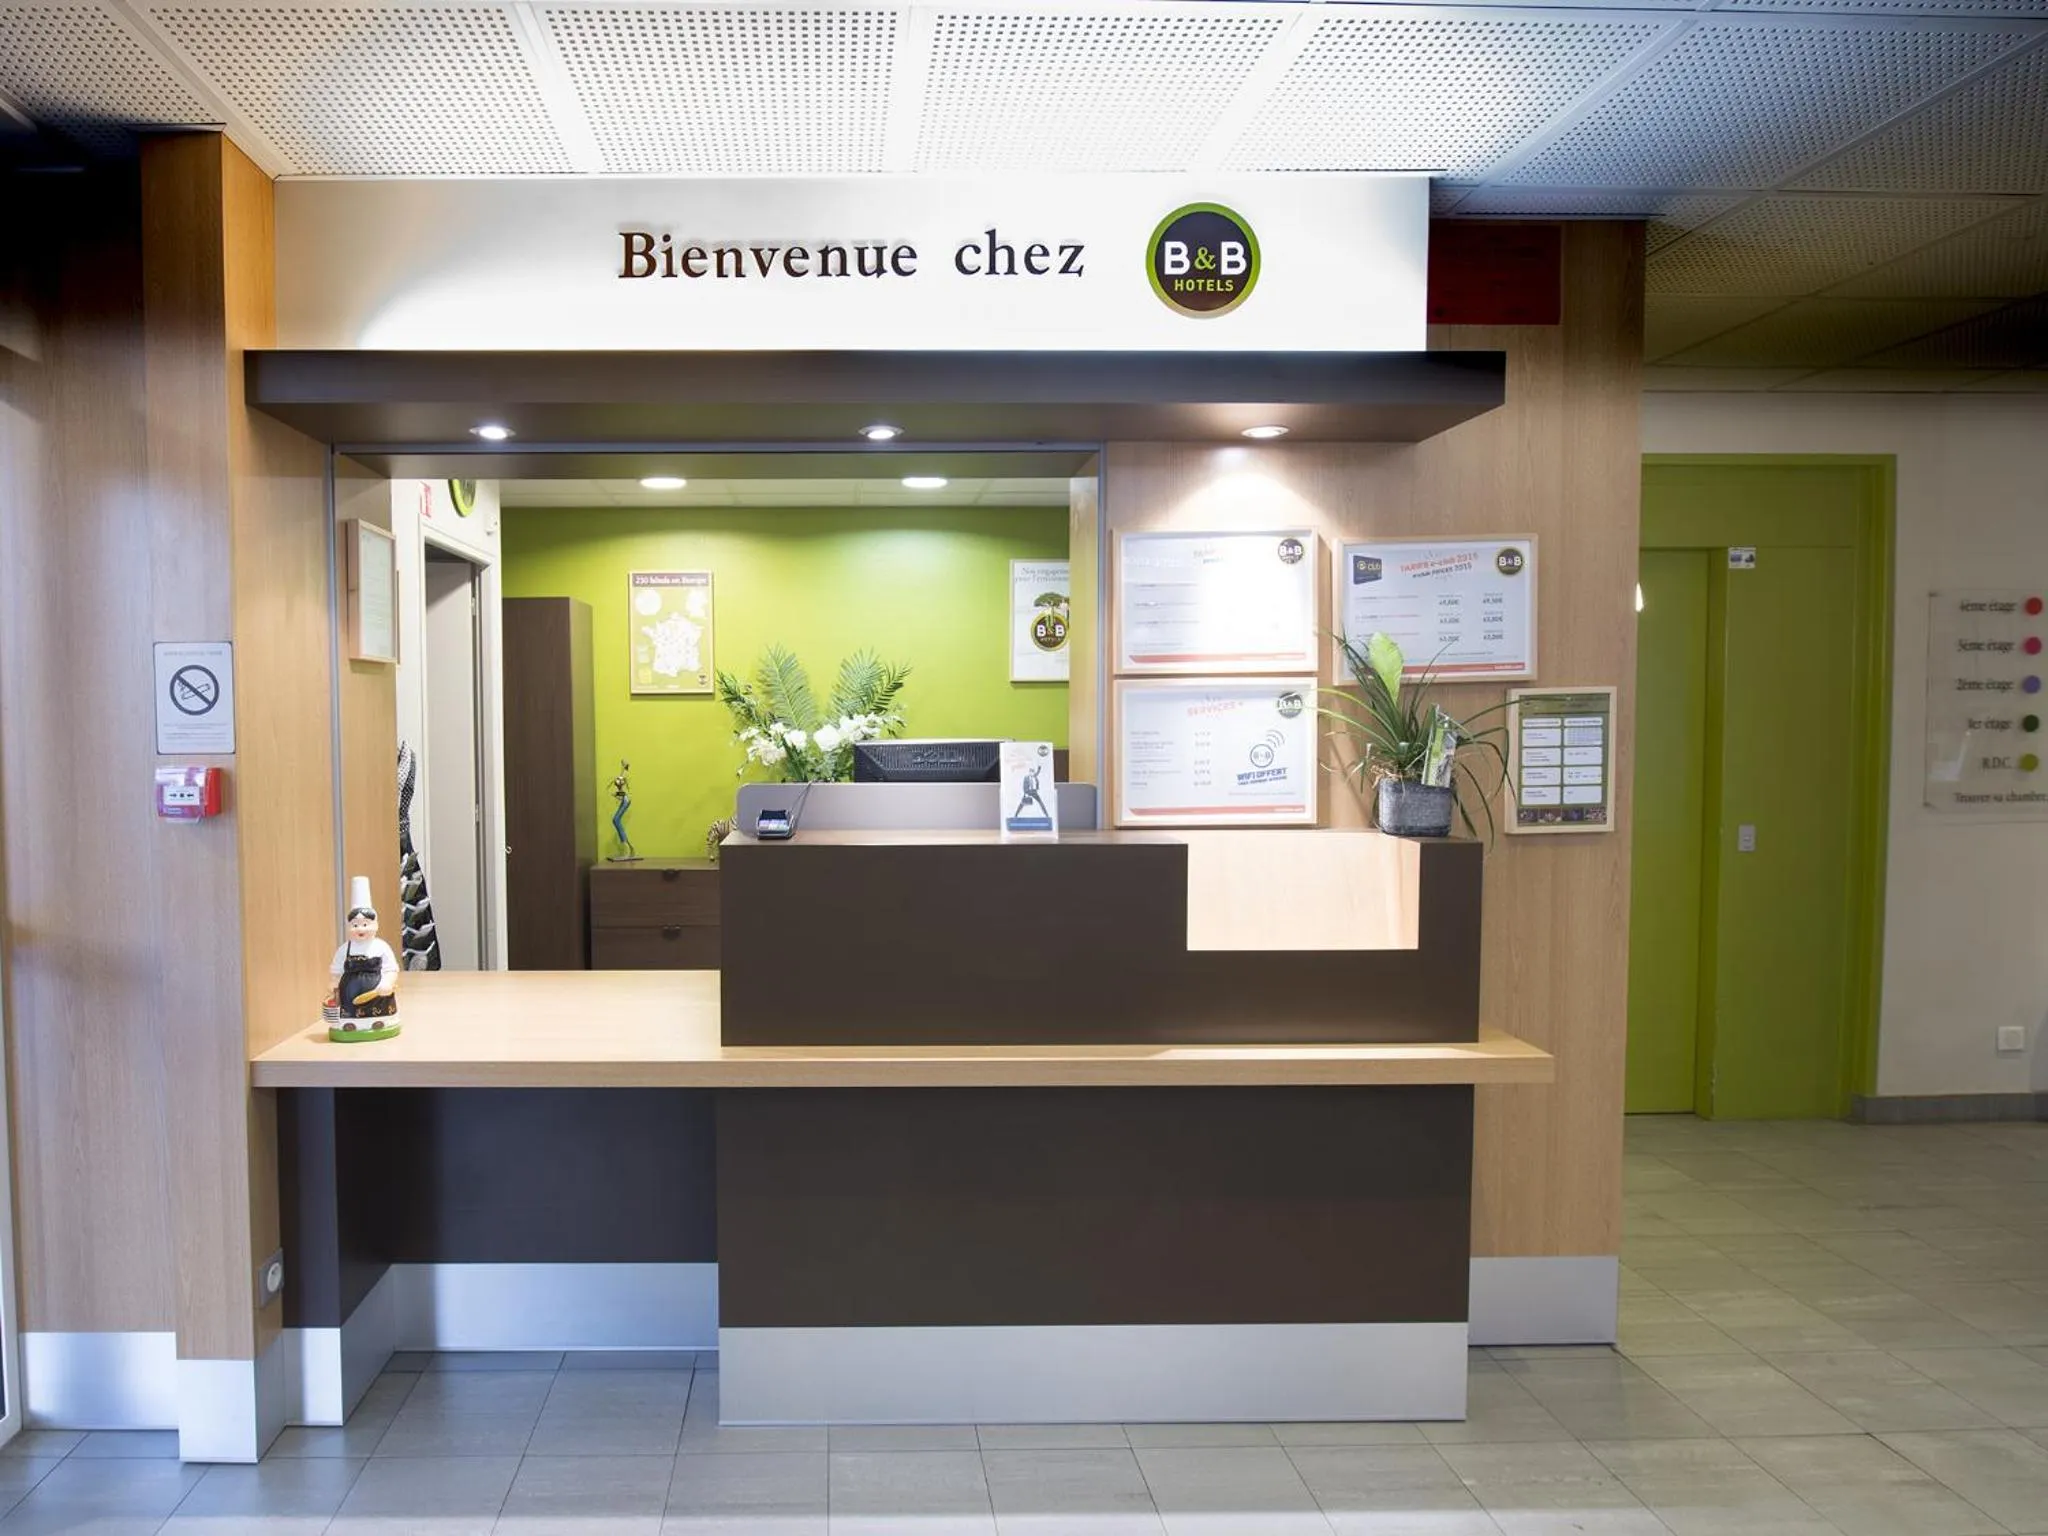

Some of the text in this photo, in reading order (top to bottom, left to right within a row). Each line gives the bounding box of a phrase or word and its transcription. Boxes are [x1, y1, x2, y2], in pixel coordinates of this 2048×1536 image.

[618, 228, 1085, 279] Bienvenue chez
[1164, 241, 1247, 275] B&B
[1174, 279, 1234, 292] HOTELS
[1499, 555, 1522, 567] B&B
